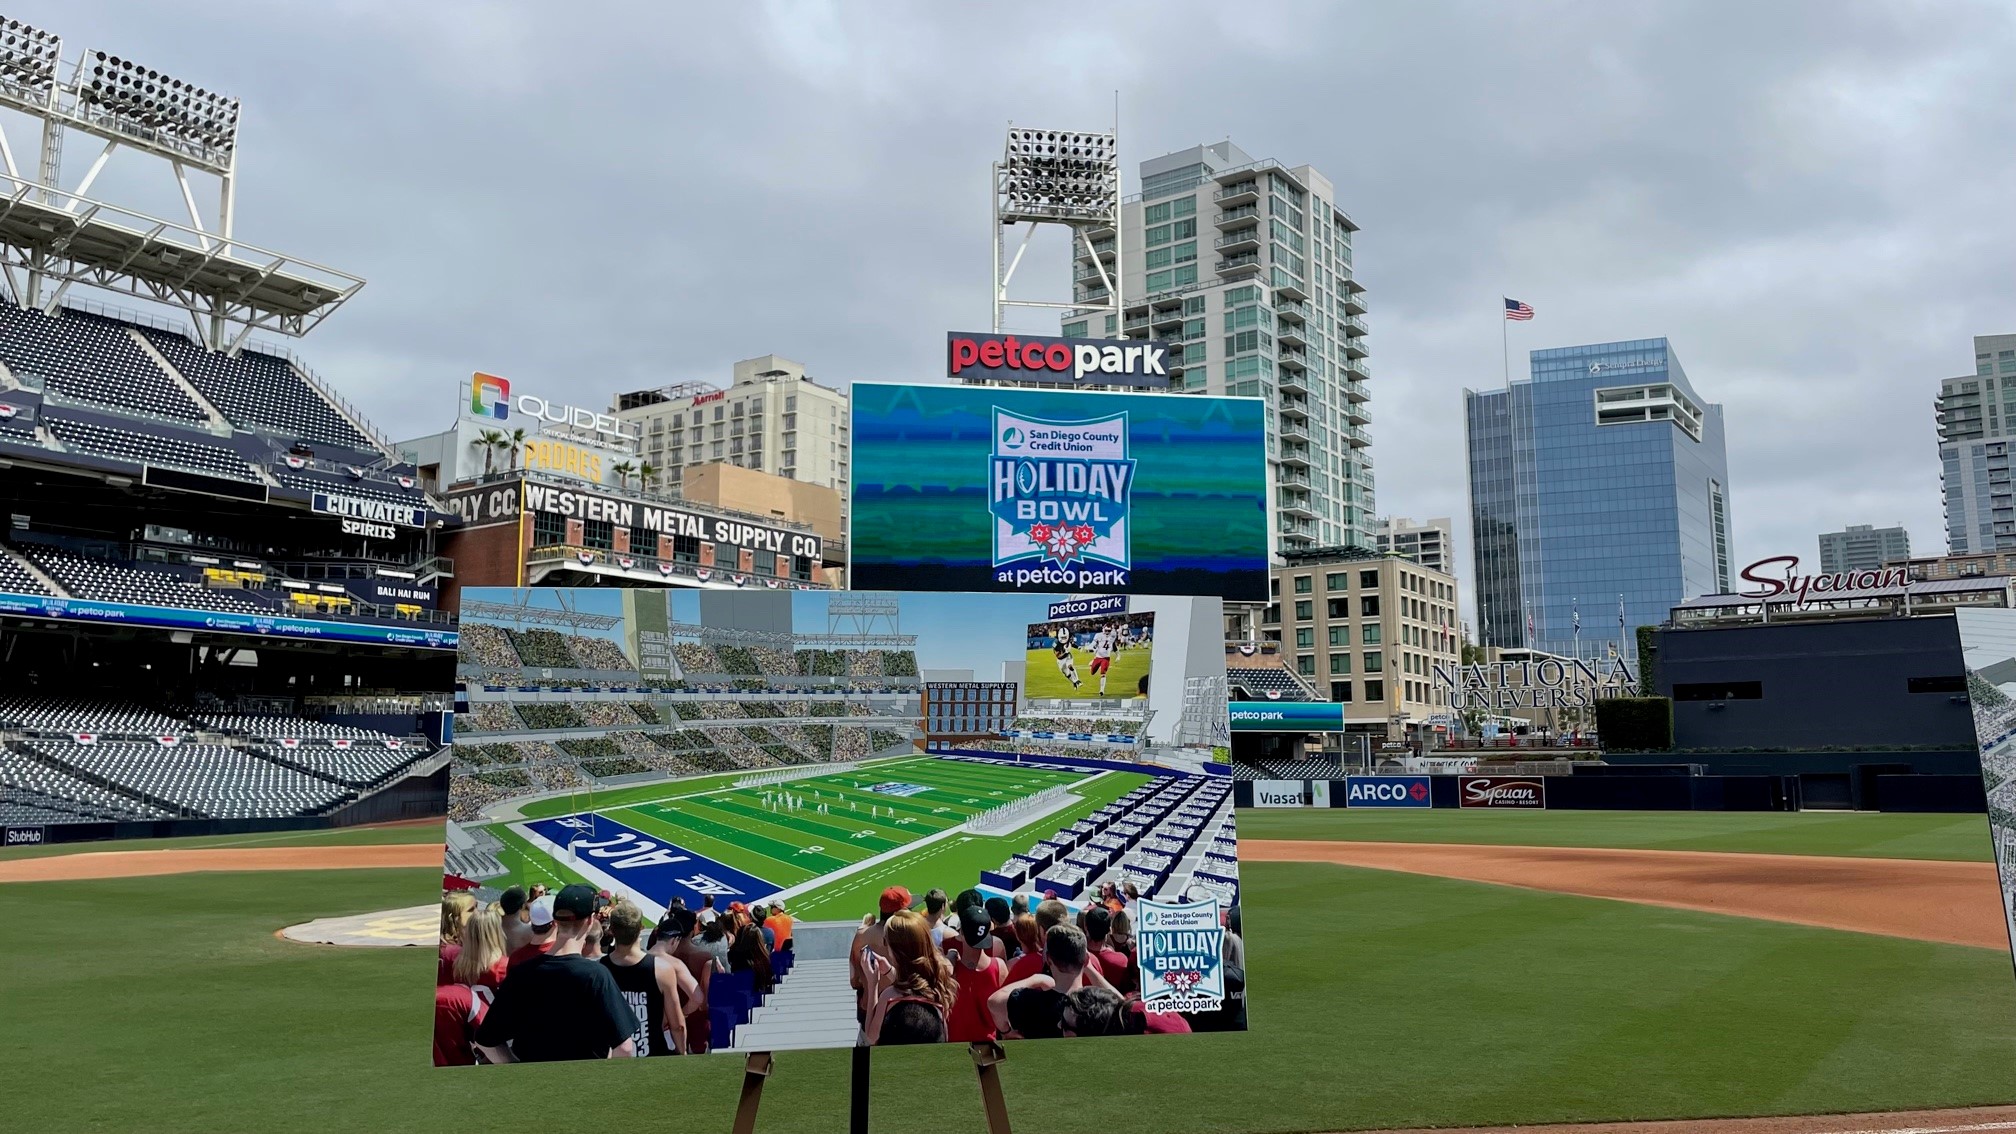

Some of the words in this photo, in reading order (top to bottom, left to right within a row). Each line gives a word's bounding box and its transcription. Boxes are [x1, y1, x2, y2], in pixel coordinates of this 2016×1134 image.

[691, 390, 725, 407] Marriott
[517, 395, 640, 441] QUIDEL
[1029, 430, 1049, 440] San
[1051, 430, 1081, 442] Diego
[1083, 431, 1119, 444] County
[1029, 441, 1061, 451] Credit
[1063, 442, 1093, 452] Union
[525, 439, 602, 484] PADRES
[994, 459, 1128, 504] HOLIDAY
[326, 495, 415, 525] CUTWATER
[448, 494, 484, 523] PLY
[1017, 500, 1108, 522] BOWL
[341, 520, 396, 540] SPIRITS
[524, 484, 633, 526] WESTERN
[642, 505, 710, 540] METAL
[715, 520, 786, 553] SUPPLY
[791, 535, 821, 559] CO.
[998, 570, 1014, 583] at
[1016, 567, 1076, 587] petco
[1079, 569, 1126, 588] park
[1738, 555, 1915, 608] Sycuan
[377, 586, 396, 598] BALI
[397, 589, 412, 600] HAI
[412, 590, 431, 601] RUM
[77, 606, 104, 616] petco
[104, 609, 125, 618] park
[1050, 601, 1088, 618] petco
[1090, 596, 1123, 613] park
[282, 624, 304, 633] petco
[304, 626, 321, 635] park
[1102, 640, 1110, 651] 4
[1231, 710, 1260, 721] petco
[1260, 711, 1284, 722] park
[1381, 741, 1402, 749] petco
[1259, 792, 1304, 805] Viasat
[1349, 784, 1407, 801] ARCO
[1465, 779, 1536, 806] Sycuan
[8, 830, 41, 843] StubHub
[572, 832, 691, 870] ACC
[1173, 911, 1191, 920] Diego
[1191, 911, 1213, 919] County
[1141, 931, 1220, 961] HOLIDAY
[1155, 956, 1210, 970] BOWL
[1147, 1002, 1156, 1010] at
[1158, 1000, 1192, 1013] petco
[1193, 999, 1220, 1012] park
